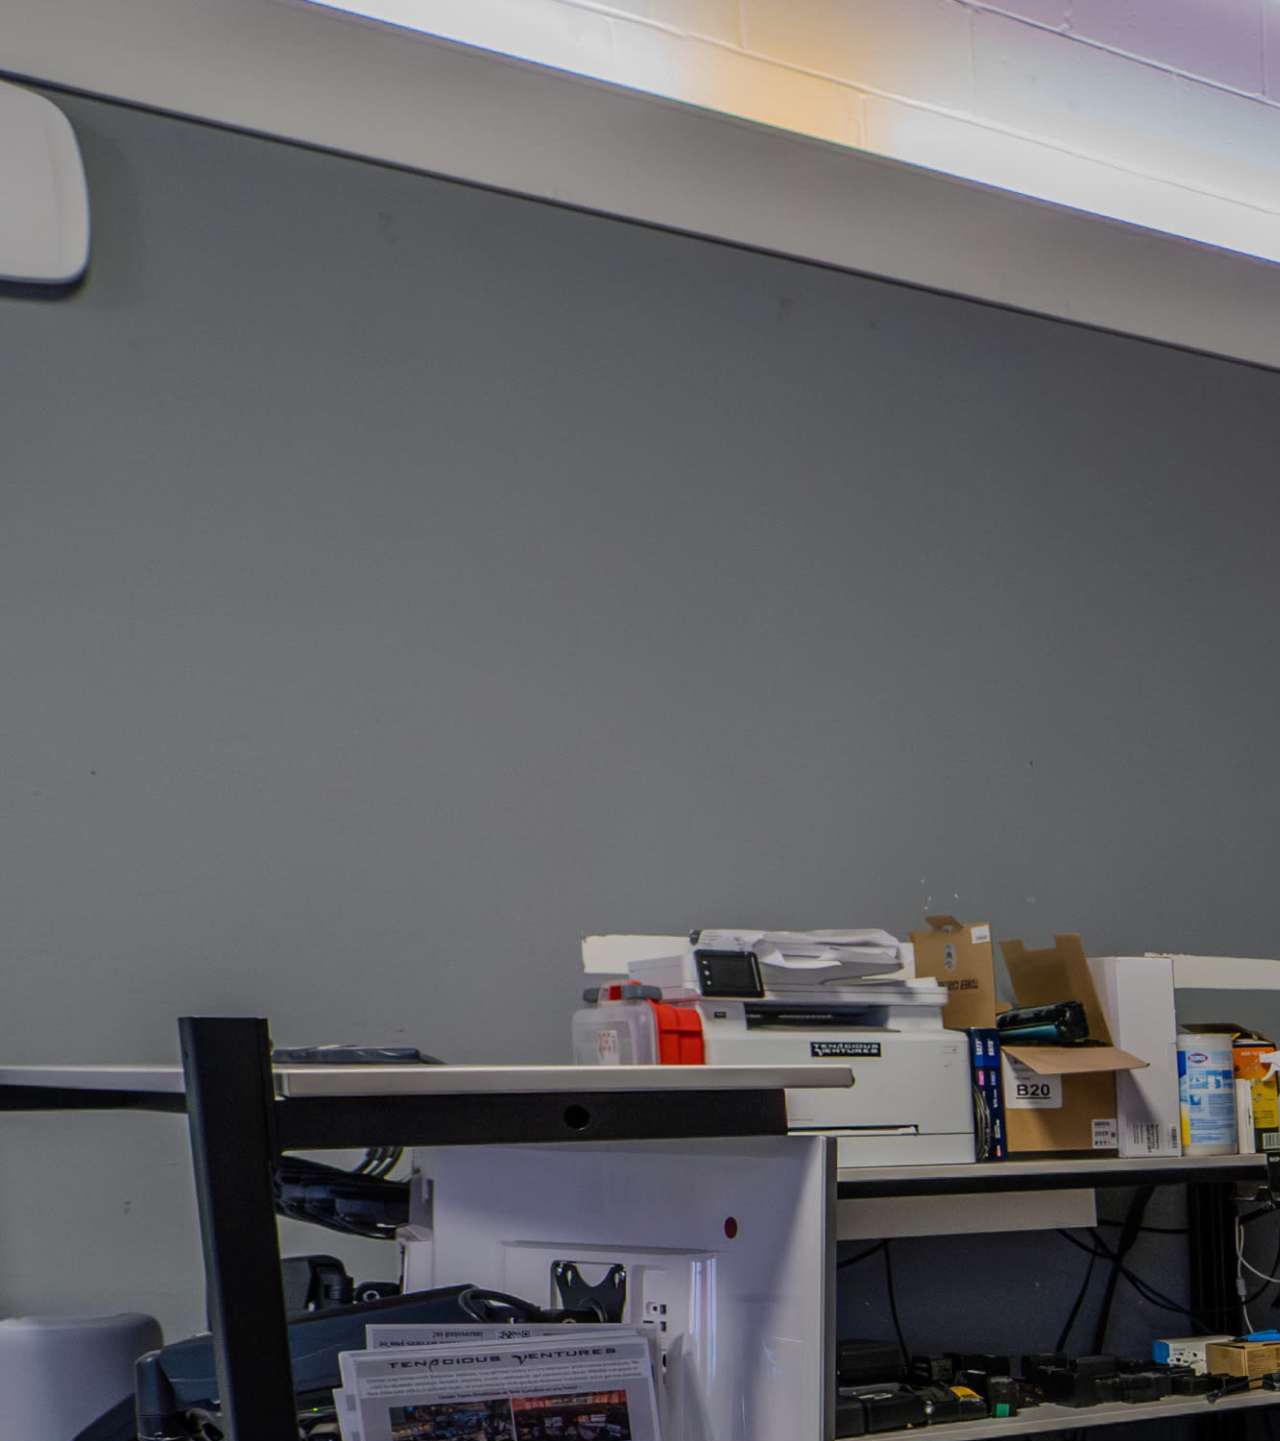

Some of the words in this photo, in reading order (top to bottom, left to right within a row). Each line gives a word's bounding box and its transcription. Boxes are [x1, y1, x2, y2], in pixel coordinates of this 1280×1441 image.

[1016, 1083, 1051, 1097] B20
[387, 1354, 501, 1371] TENACIOUS
[511, 1347, 616, 1367] VENTURES
